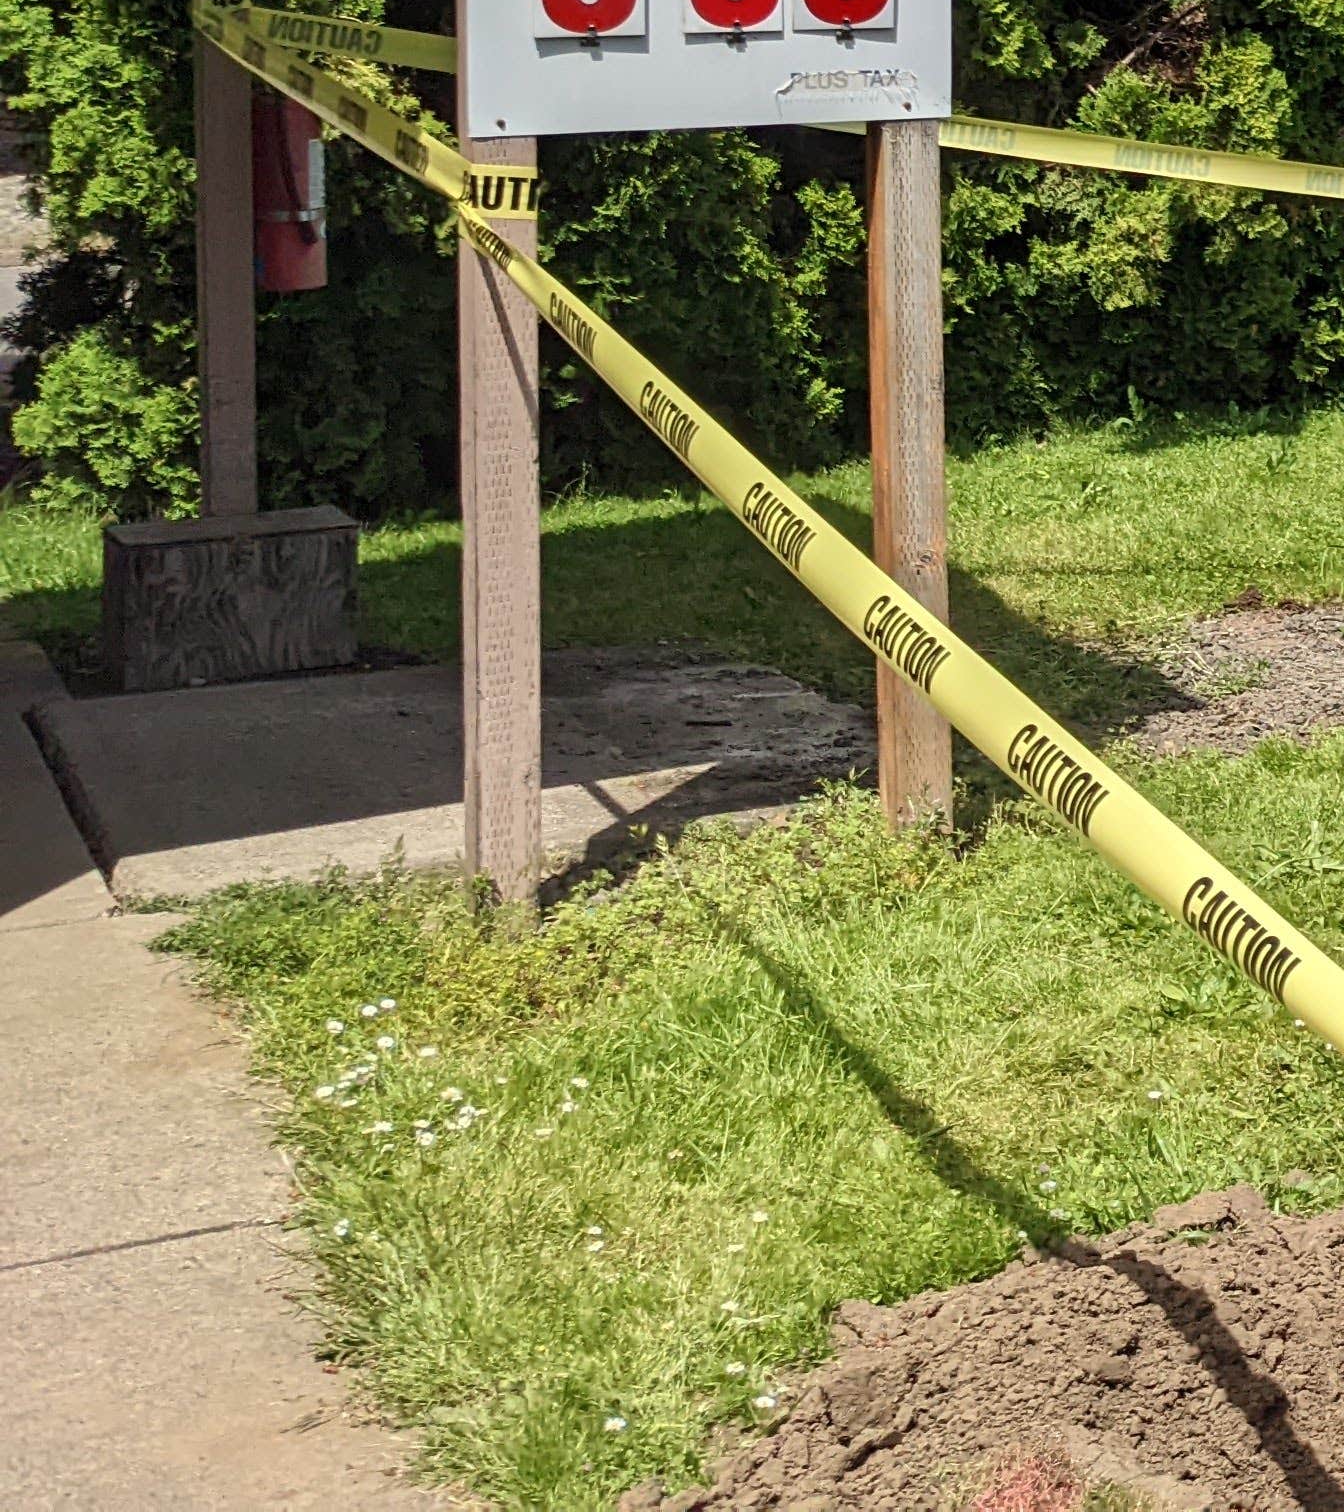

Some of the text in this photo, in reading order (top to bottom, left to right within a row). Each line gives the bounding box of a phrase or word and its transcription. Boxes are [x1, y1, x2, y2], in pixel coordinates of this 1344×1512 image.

[857, 68, 900, 87] TAX
[550, 291, 598, 358] CAUTION
[639, 380, 700, 461] CAUTION
[742, 481, 817, 572] CAUTION
[863, 594, 952, 695] CAUTION
[1007, 723, 1111, 838] CAUTION
[1182, 876, 1303, 1005] CAUTION
